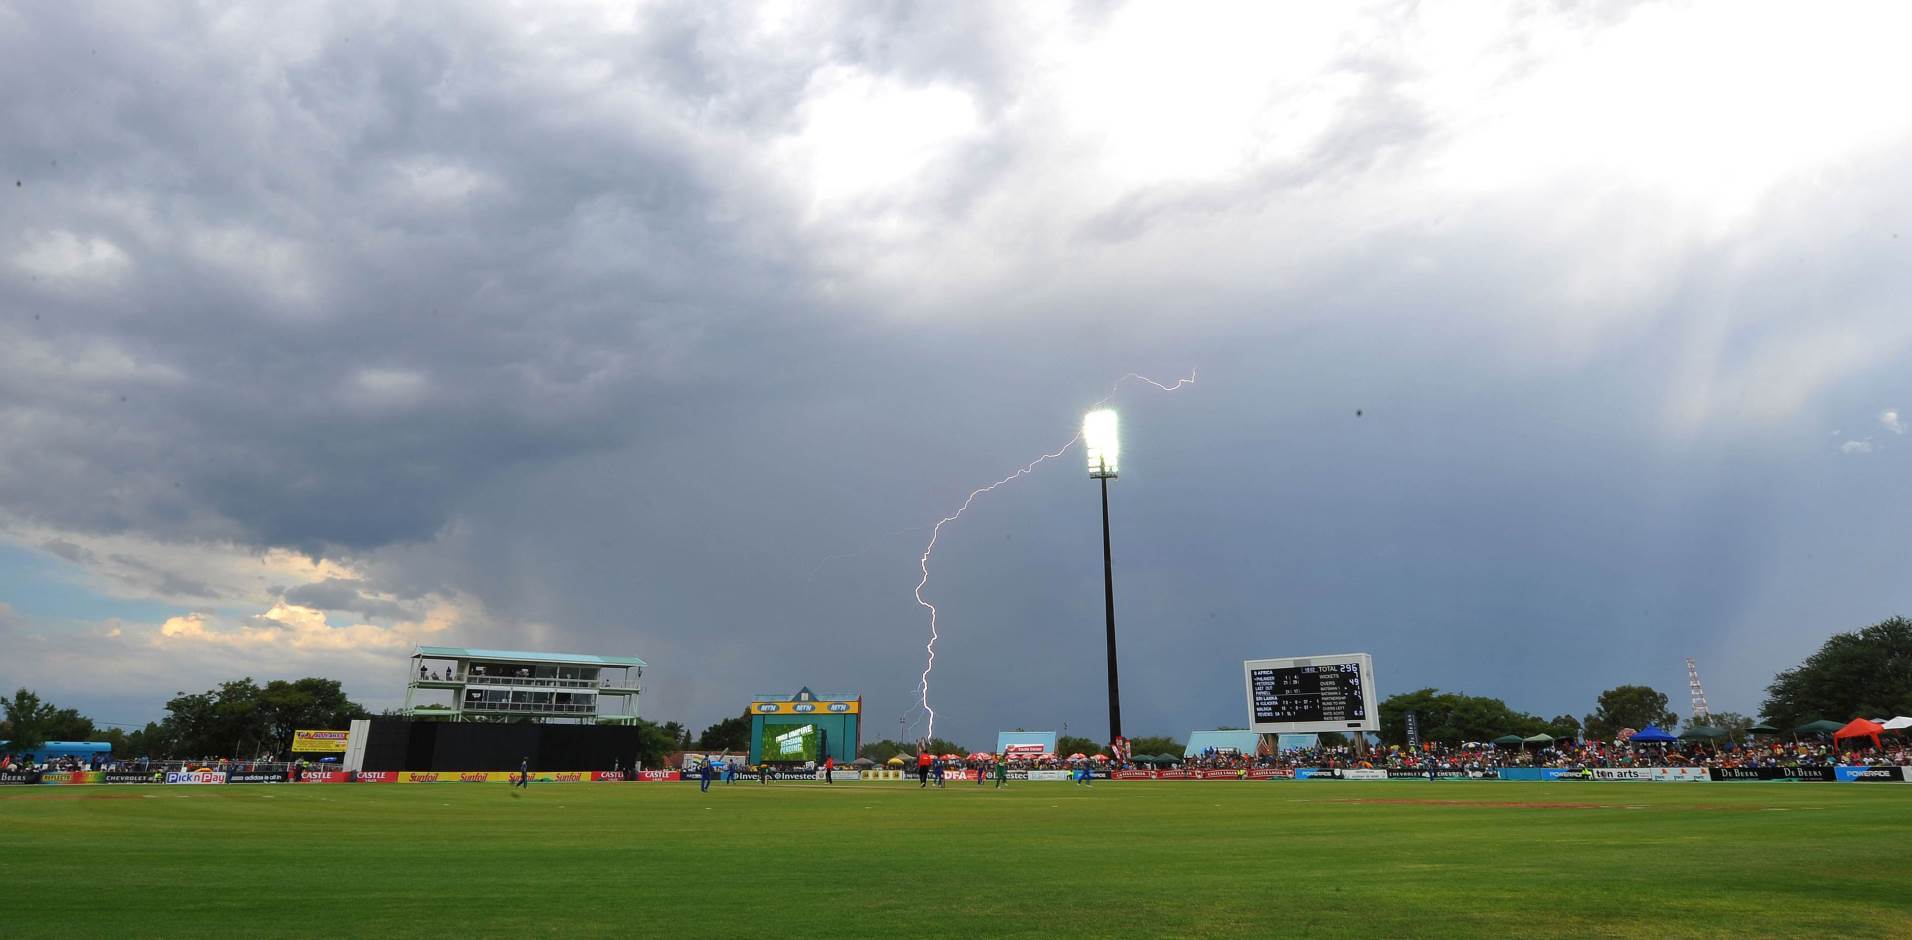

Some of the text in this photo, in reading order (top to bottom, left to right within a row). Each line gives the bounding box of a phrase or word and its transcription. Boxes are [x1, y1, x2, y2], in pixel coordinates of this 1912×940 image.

[1340, 664, 1358, 673] 296
[789, 725, 813, 738] UMPIRE
[1, 772, 26, 781] BEERS
[944, 771, 967, 779] DFA
[1617, 769, 1639, 778] arts
[1734, 768, 1759, 777] BEERS
[1798, 767, 1823, 777] BEERS
[168, 773, 192, 783] Pick
[202, 773, 225, 784] Pay
[409, 773, 439, 782] Sunfoil
[460, 773, 488, 782] Sunfoil
[555, 773, 581, 781] Sunfoil
